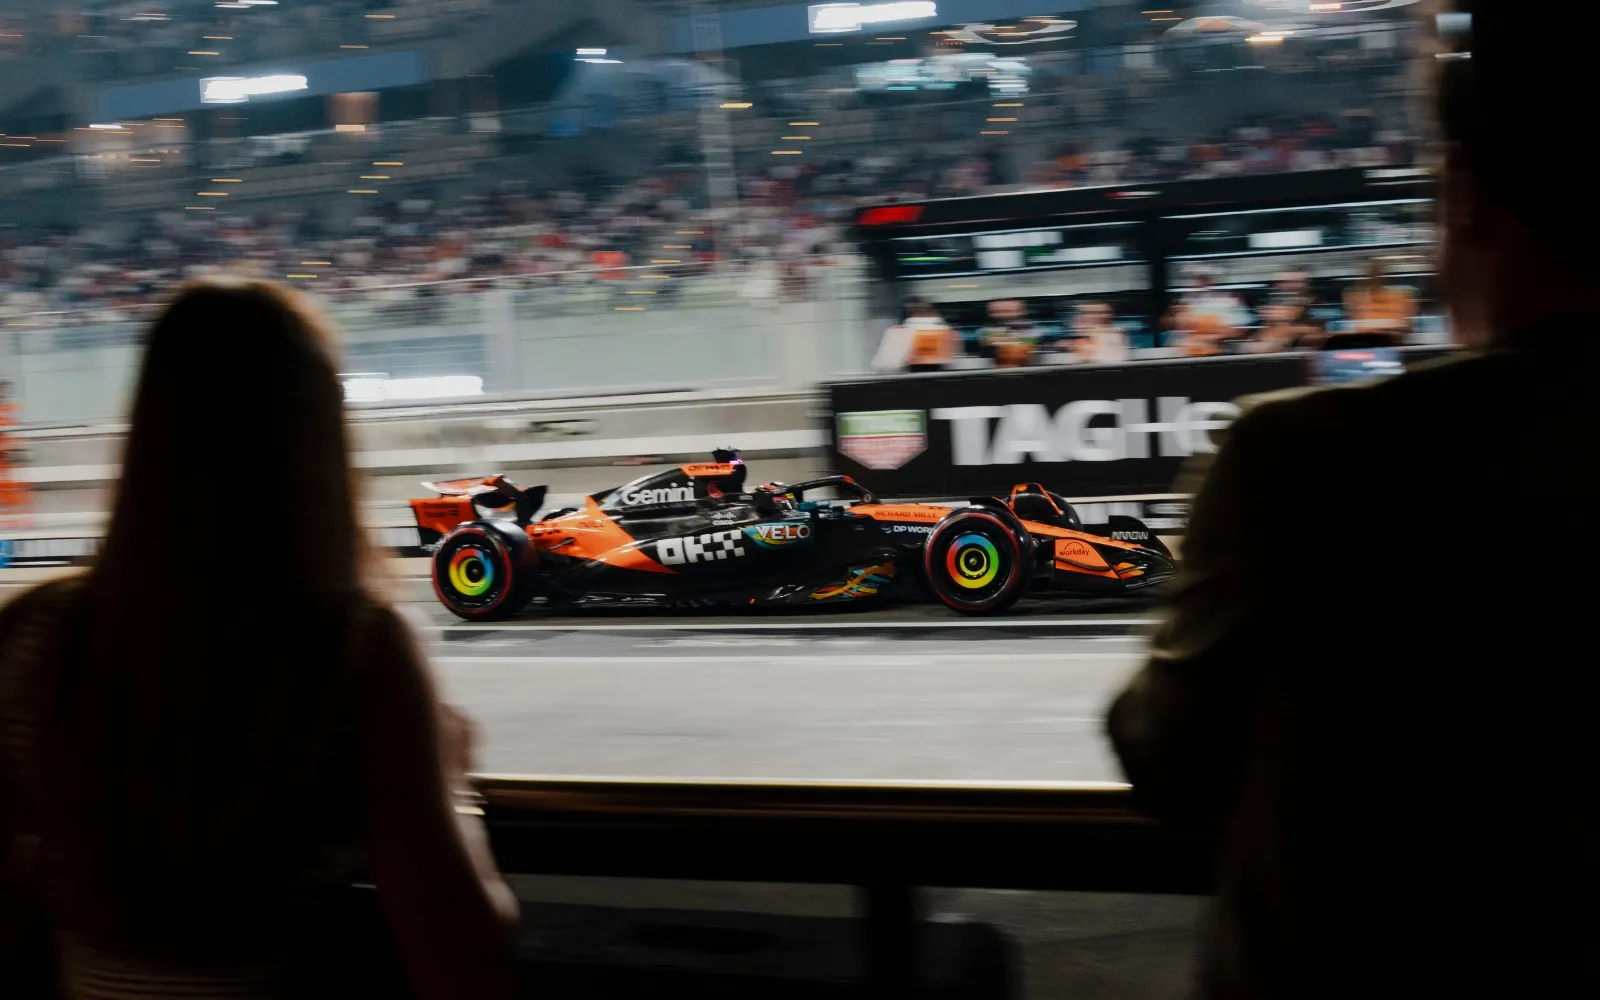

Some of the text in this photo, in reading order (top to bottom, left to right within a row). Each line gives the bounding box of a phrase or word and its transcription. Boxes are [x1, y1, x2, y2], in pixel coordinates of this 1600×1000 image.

[621, 481, 695, 506] Gemini
[755, 524, 811, 540] VELO
[893, 525, 907, 533] DP
[656, 529, 746, 566] OKX
[1059, 548, 1090, 557] workday
